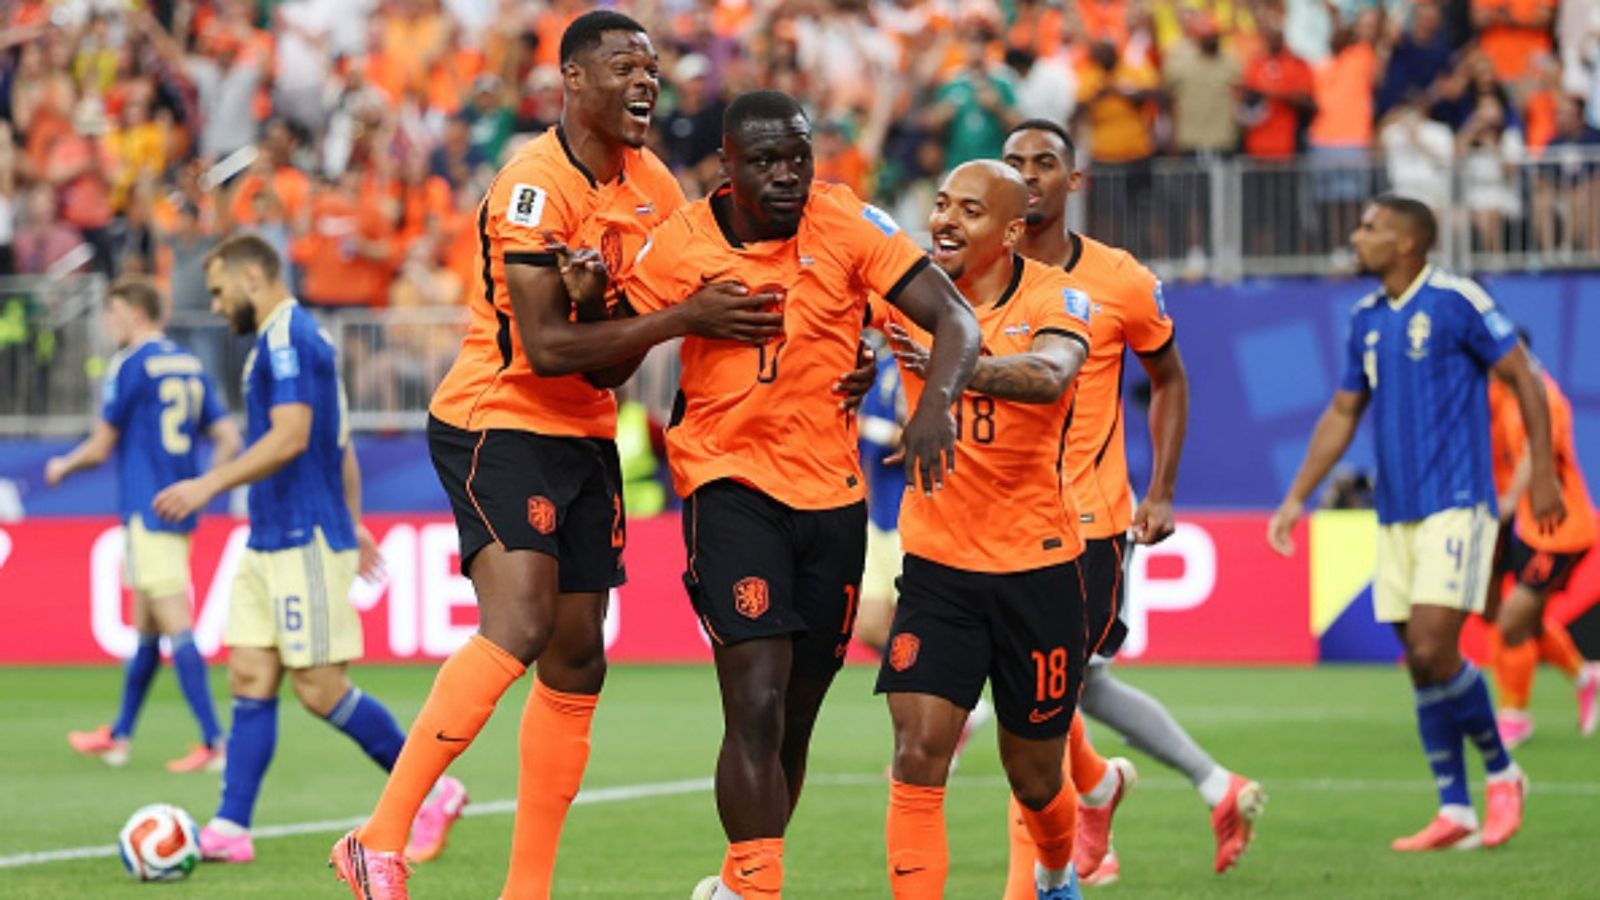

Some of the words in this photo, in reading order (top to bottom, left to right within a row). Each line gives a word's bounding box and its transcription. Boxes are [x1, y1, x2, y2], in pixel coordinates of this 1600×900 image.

[159, 376, 205, 455] 21
[956, 396, 995, 444] 18
[1445, 537, 1464, 571] 4
[1031, 646, 1067, 702] 18
